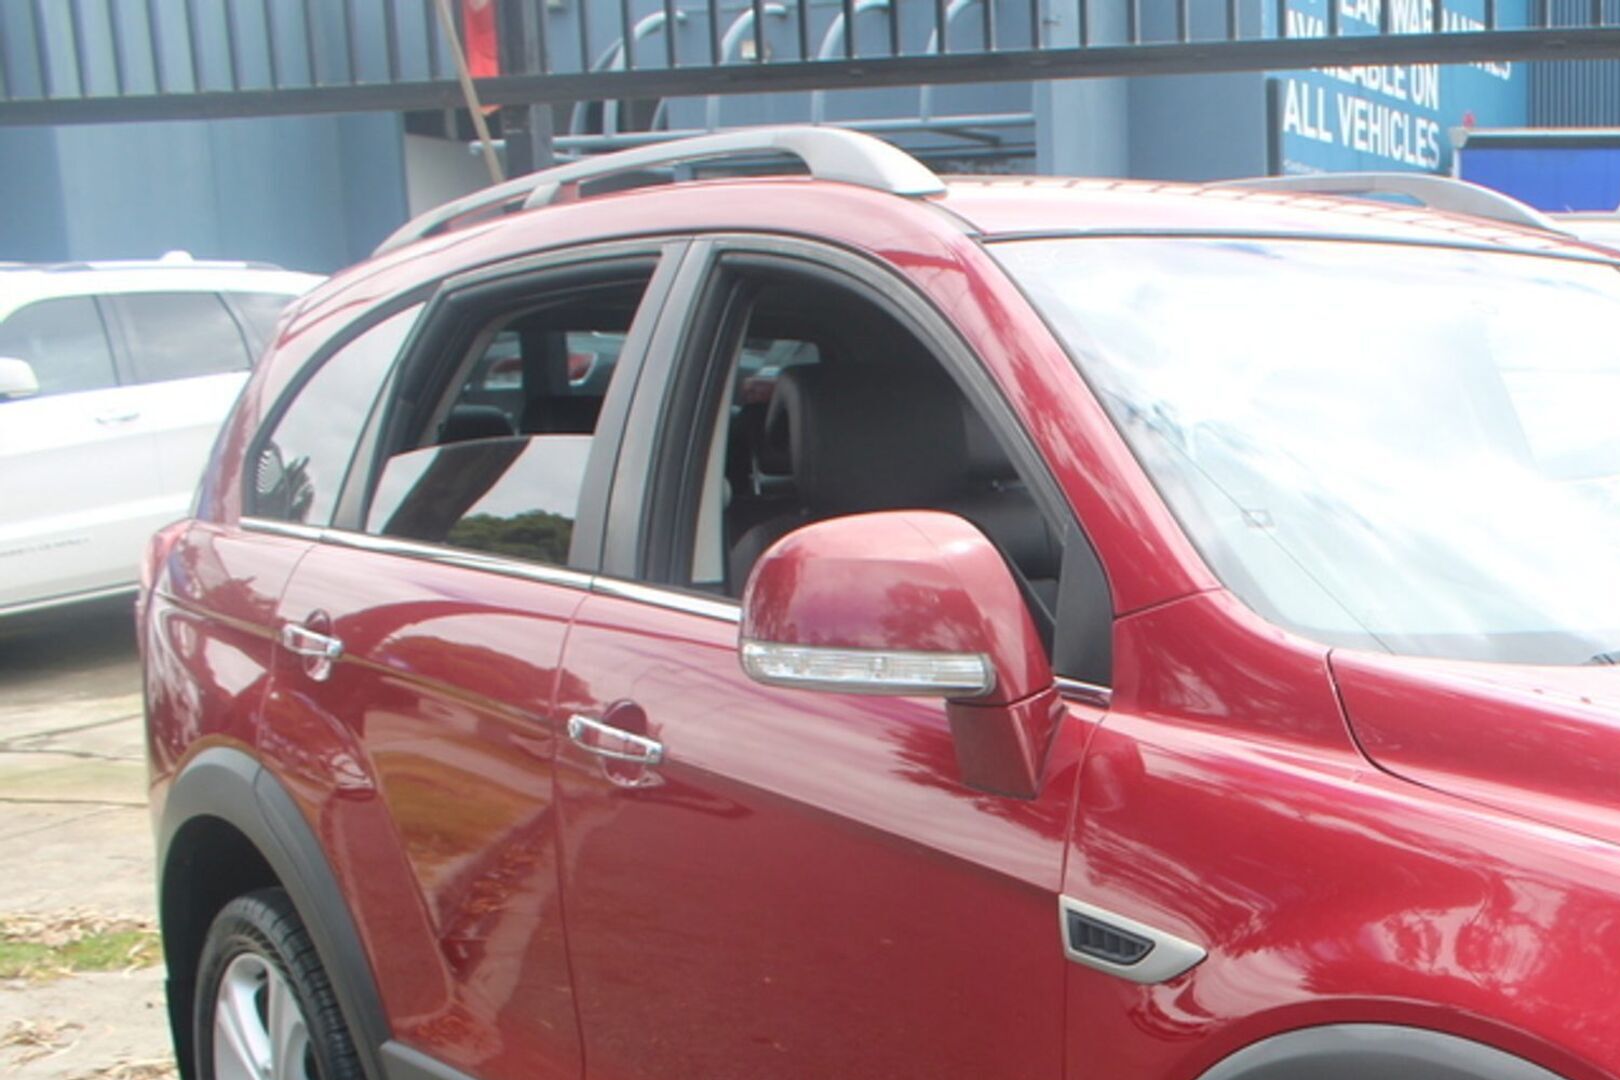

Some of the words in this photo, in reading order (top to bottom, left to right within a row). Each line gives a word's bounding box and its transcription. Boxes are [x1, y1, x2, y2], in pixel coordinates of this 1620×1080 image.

[1410, 64, 1439, 111] ON
[1283, 77, 1334, 144] ALL
[1336, 91, 1440, 171] VEHICLES
